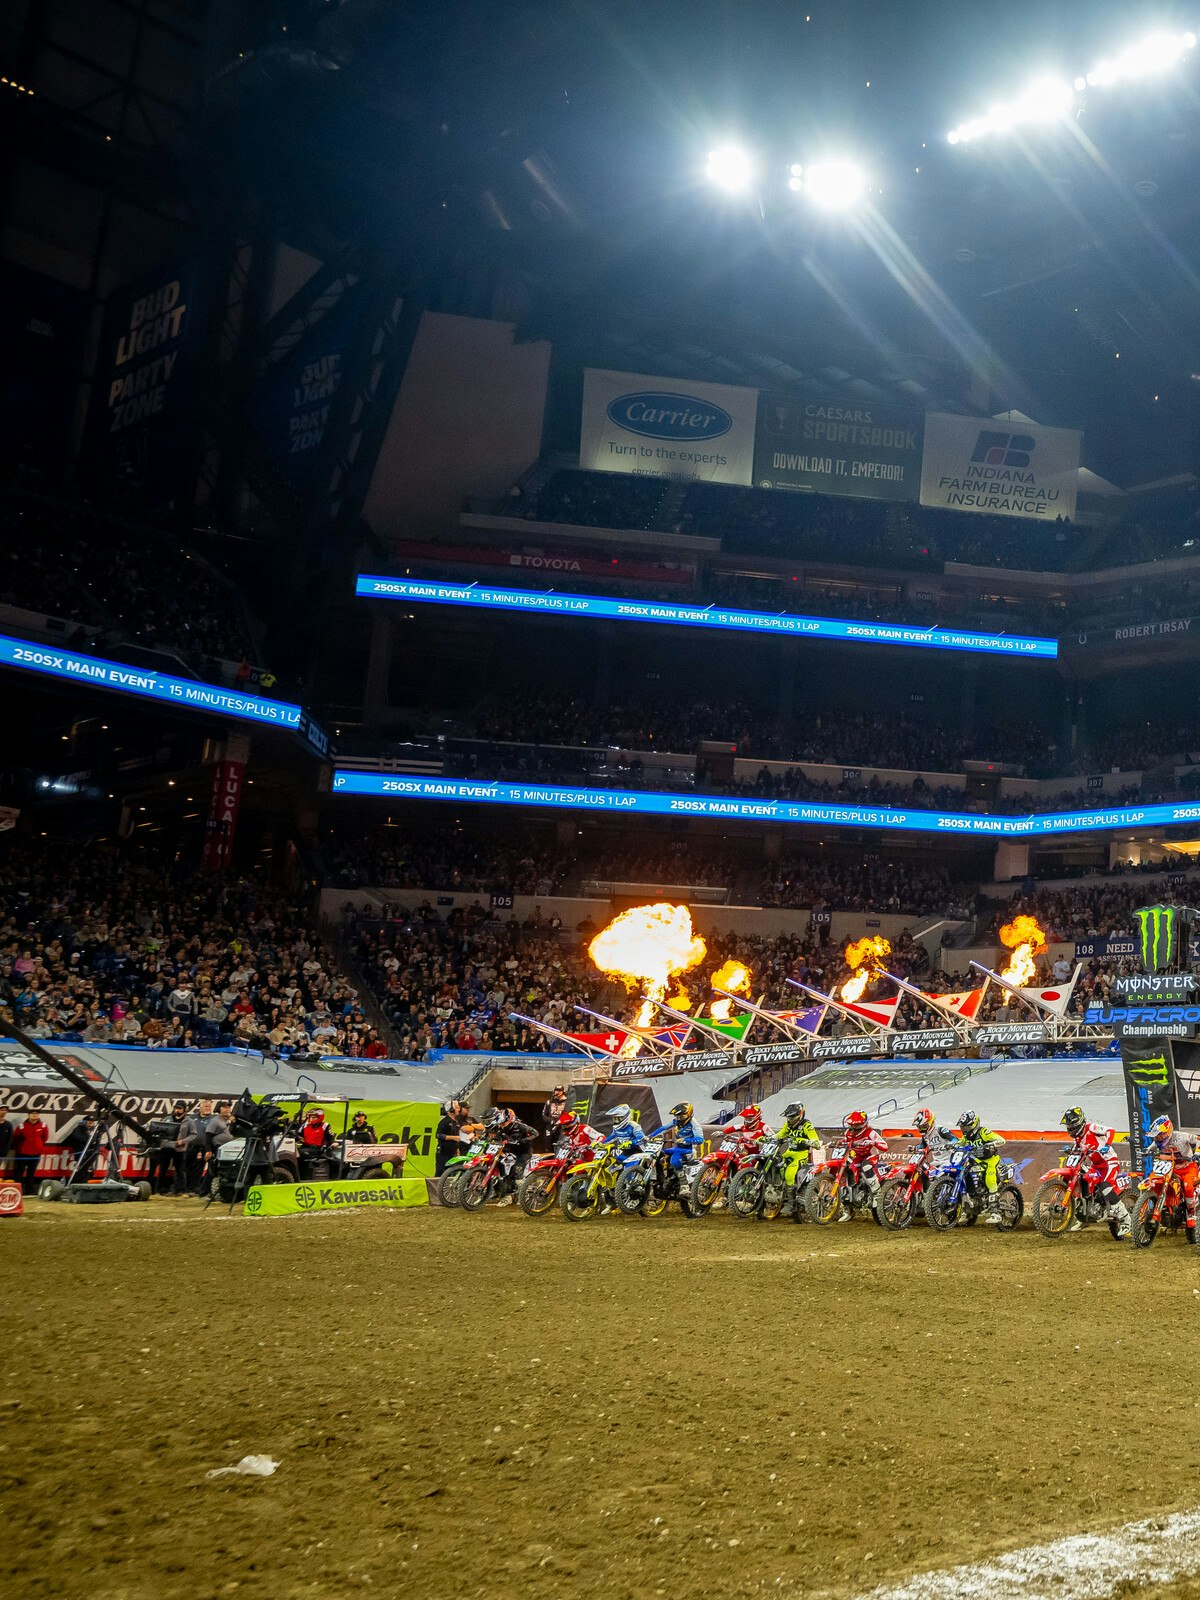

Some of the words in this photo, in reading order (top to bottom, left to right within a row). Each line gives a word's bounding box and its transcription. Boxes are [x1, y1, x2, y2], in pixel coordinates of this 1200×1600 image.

[133, 280, 180, 322] BUD
[115, 305, 187, 366] LIGHT
[107, 351, 178, 407] PARTY
[110, 383, 166, 433] ZONE
[626, 402, 716, 428] Carrier
[805, 405, 872, 423] CAESARS
[803, 420, 917, 450] SPORTSBOOK
[608, 442, 636, 455] Turn
[640, 445, 653, 457] to
[656, 447, 676, 460] the
[680, 451, 727, 465] experts
[773, 452, 832, 474] DOWNLOAD
[836, 460, 848, 476] IT,
[852, 462, 904, 481] EMPEROR!
[966, 466, 1035, 484] INDIANA
[946, 492, 1047, 514] INSURANCE
[524, 555, 581, 572] TOYOTA
[374, 583, 406, 594] 250SX
[409, 587, 436, 597] MAIN
[438, 589, 471, 600] EVENT
[481, 593, 490, 601] 15
[493, 594, 562, 608] MINUTES/PLUS
[571, 601, 589, 611] LAP
[617, 605, 649, 616] 250SX
[651, 609, 676, 618] MAIN
[678, 611, 709, 621] EVENT
[718, 615, 727, 623] 15
[729, 616, 795, 629] MINUTES/PLUS
[803, 623, 819, 631] LAP
[847, 627, 876, 637] 250SX
[878, 630, 902, 639] MAIN
[904, 633, 933, 642] EVENT
[941, 636, 950, 644] 15
[952, 637, 1013, 650] MINUTES/PLUS
[1021, 642, 1037, 651] LAP
[1115, 625, 1157, 640] ROBERT
[1159, 620, 1191, 634] IRSAY
[13, 648, 63, 670] 250SX
[66, 661, 107, 680] MAIN
[109, 671, 157, 691] EVENT
[169, 685, 183, 697] 15
[186, 688, 277, 719] MINUTES/PLUS
[1088, 778, 1103, 787] 307
[383, 781, 423, 793] 250SX
[424, 784, 458, 795] MAIN
[459, 786, 498, 797] EVENT
[509, 790, 520, 800] 15
[523, 791, 605, 806] MINUTES/PLUS
[615, 797, 637, 807] LAP
[670, 800, 707, 811] 250SX
[709, 803, 739, 813] MAIN
[741, 805, 777, 816] EVENT
[788, 808, 799, 817] 15
[801, 809, 878, 823] MINUTES/PLUS
[886, 815, 906, 824] LAP
[938, 818, 972, 829] 250SX
[974, 820, 1002, 830] MAIN
[1003, 821, 1034, 832] EVENT
[1043, 819, 1052, 829] 15
[1054, 814, 1119, 829] MINUTES/PLUS
[1127, 813, 1144, 822] LAP
[491, 896, 512, 906] 105
[811, 913, 830, 922] 105
[1076, 944, 1094, 955] 108
[1106, 943, 1134, 954] NEED
[1116, 976, 1195, 993] MONSTER
[1089, 1001, 1104, 1009] AMA
[1128, 993, 1182, 1001] ENERGY
[1123, 1023, 1188, 1036] Championship
[832, 1148, 845, 1160] 62
[952, 1151, 963, 1163] 6
[1067, 1155, 1080, 1166] 67
[320, 1185, 404, 1205] Kawasaki
